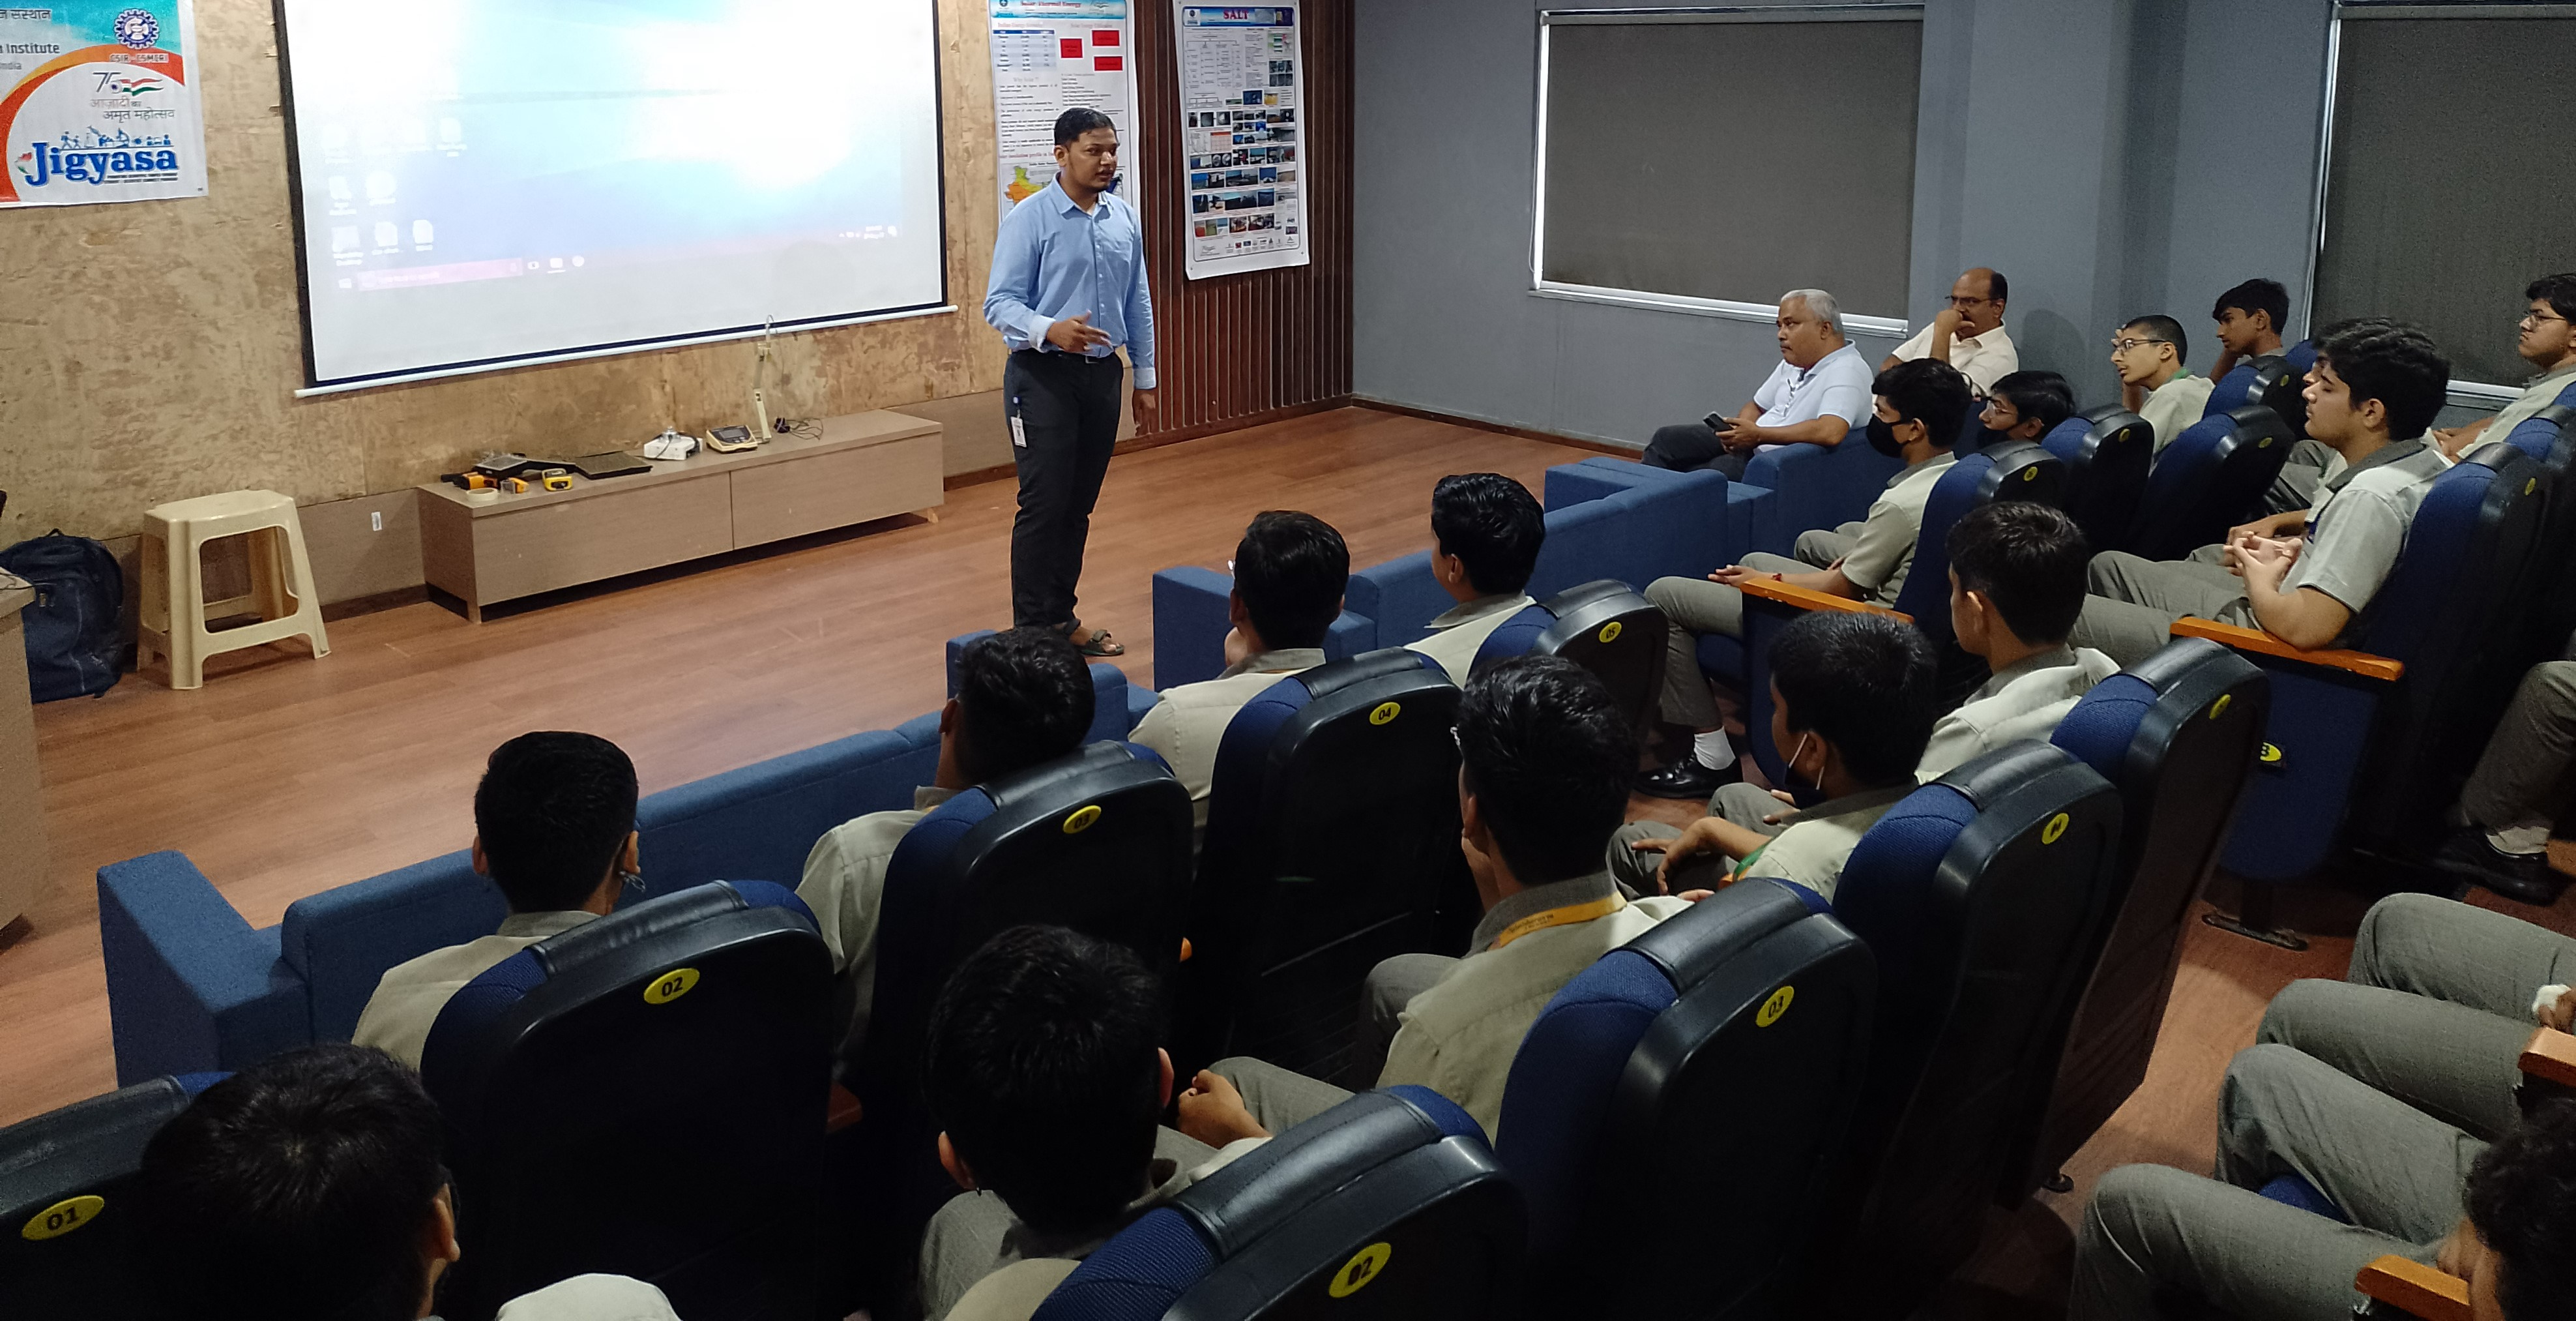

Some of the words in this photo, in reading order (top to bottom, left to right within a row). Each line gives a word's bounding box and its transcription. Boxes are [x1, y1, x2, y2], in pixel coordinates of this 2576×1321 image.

[1223, 10, 1248, 20] SALT
[6, 43, 60, 53] Institute
[103, 110, 130, 123] अमृत
[25, 142, 178, 186] Jigyasa
[1378, 707, 1392, 720] 04
[662, 976, 683, 997] 02
[47, 1206, 80, 1230] 01
[1347, 1256, 1373, 1286] 02
